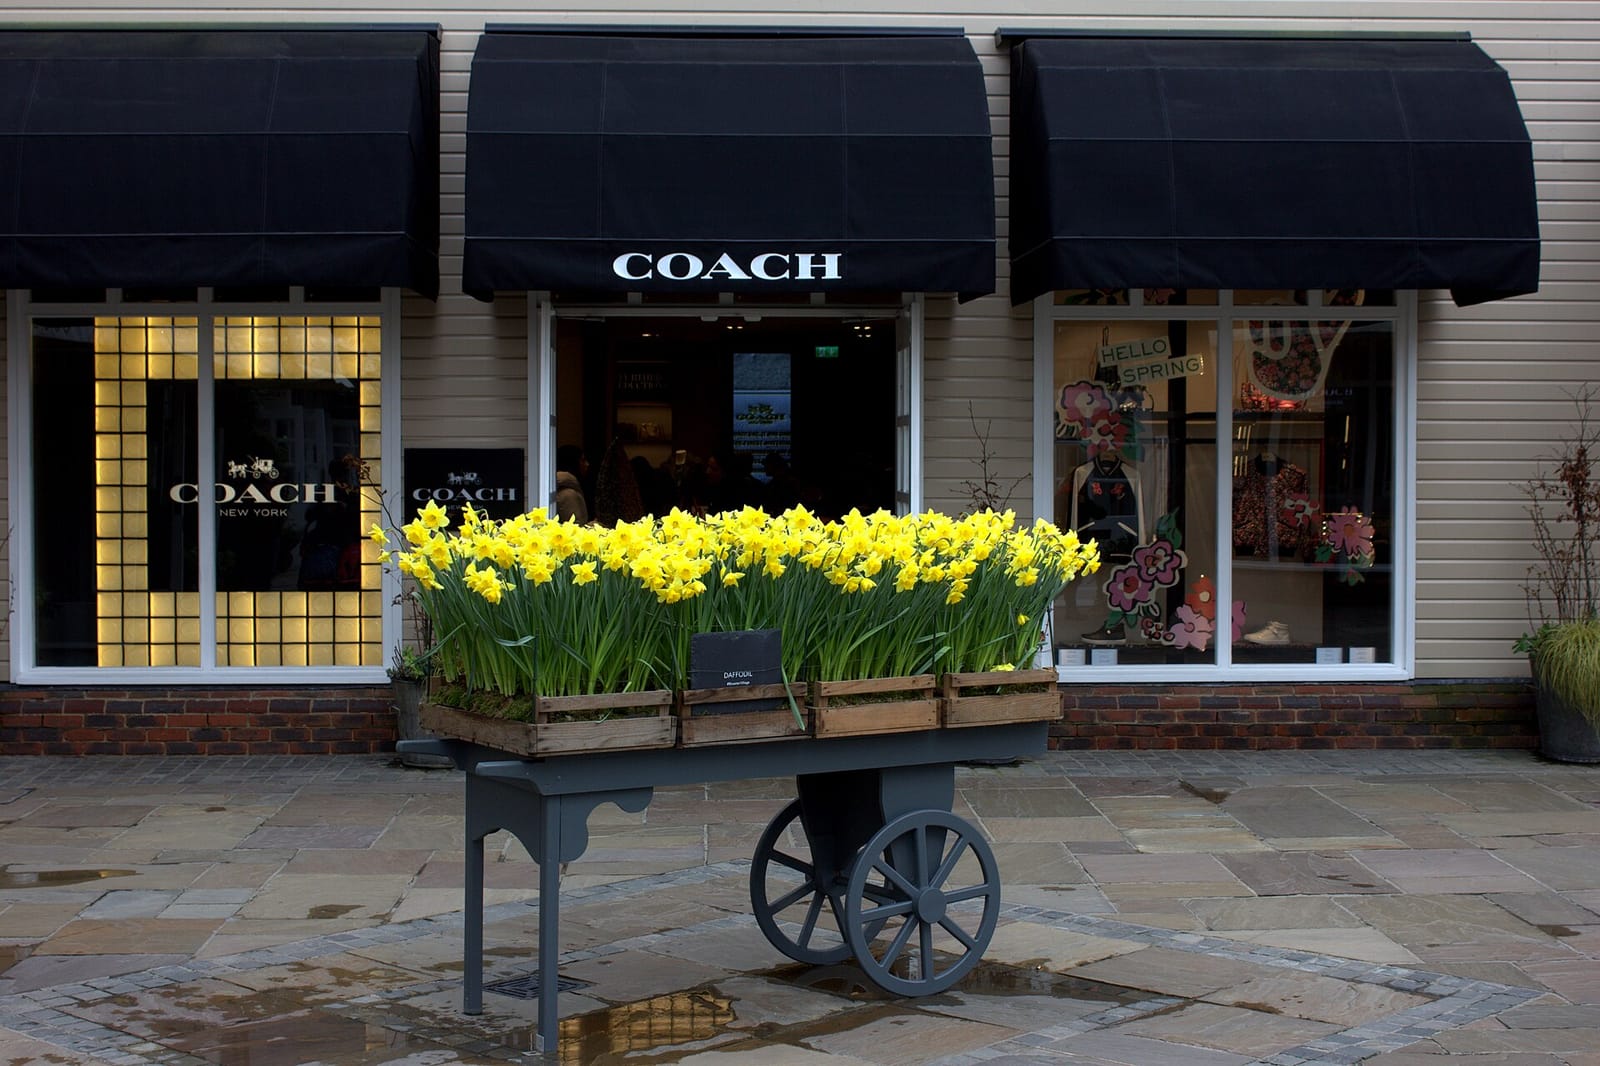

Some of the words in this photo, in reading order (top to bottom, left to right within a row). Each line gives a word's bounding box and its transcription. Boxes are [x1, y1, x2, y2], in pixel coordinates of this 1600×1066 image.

[612, 252, 842, 280] COACH
[1101, 339, 1167, 363] HELLO
[1123, 358, 1200, 383] SPRING
[169, 483, 338, 504] COACH
[412, 488, 517, 501] COACH
[219, 508, 249, 517] NEW
[253, 508, 288, 517] YORK
[723, 671, 753, 679] DAFFODIL
